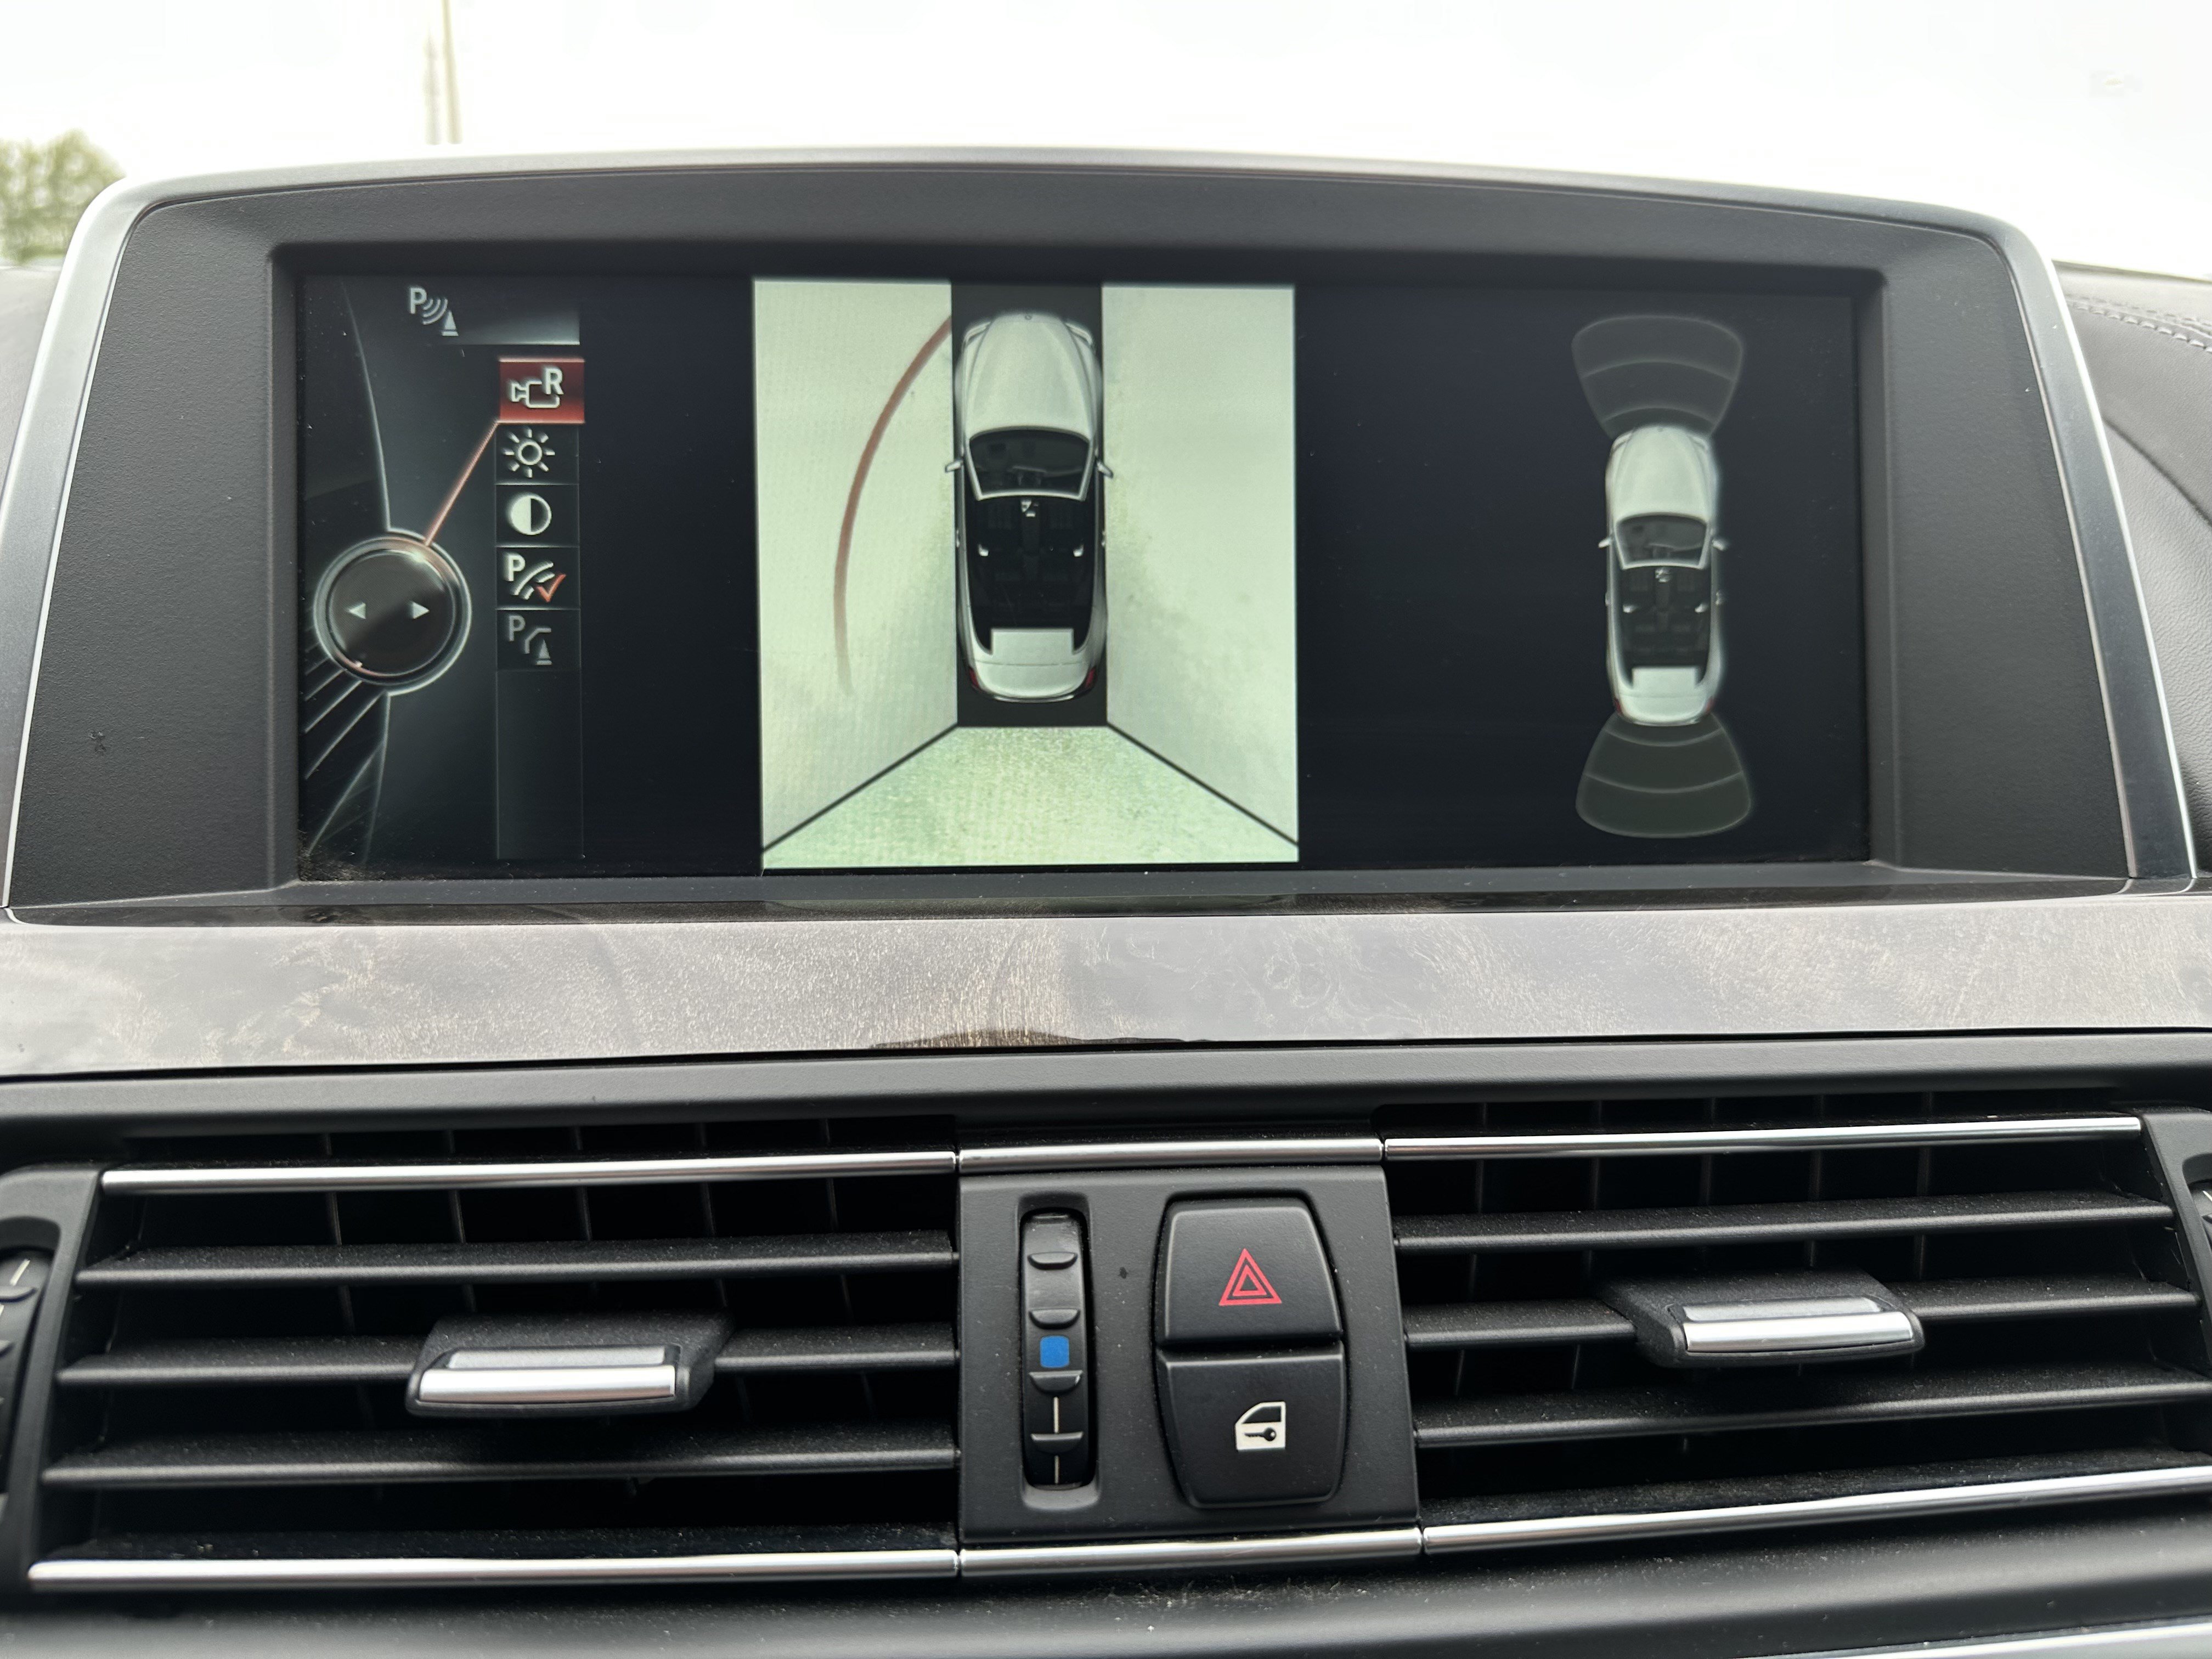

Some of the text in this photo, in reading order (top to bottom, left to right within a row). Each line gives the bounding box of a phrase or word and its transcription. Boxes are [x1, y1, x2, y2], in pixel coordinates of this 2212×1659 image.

[408, 286, 427, 314] P
[544, 368, 564, 396] R
[505, 554, 526, 582] P
[508, 616, 526, 642] P
